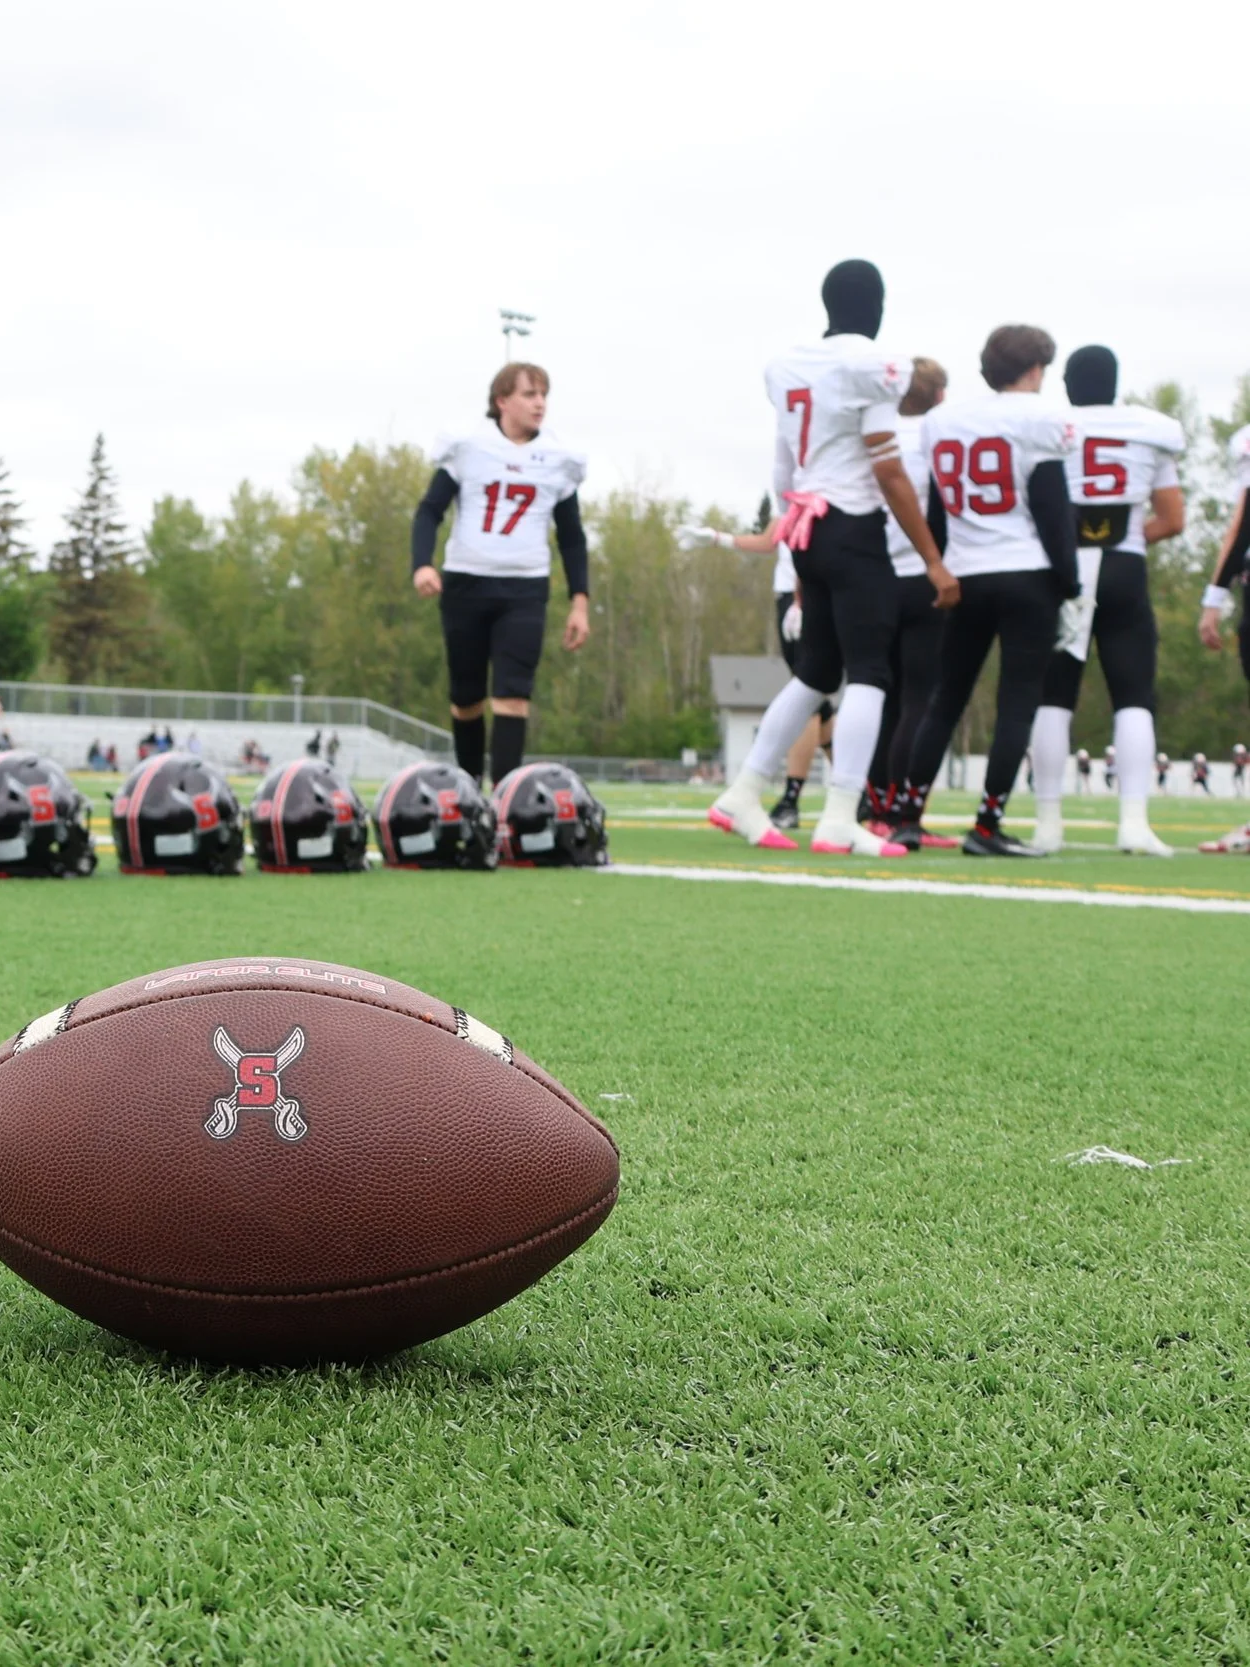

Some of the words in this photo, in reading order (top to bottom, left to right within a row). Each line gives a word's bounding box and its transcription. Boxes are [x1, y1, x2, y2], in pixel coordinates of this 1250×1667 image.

[787, 387, 812, 468] 7
[933, 436, 1017, 517] 89
[1083, 436, 1128, 497] 5
[482, 480, 537, 536] 17
[27, 784, 57, 824] S
[192, 791, 220, 832] S
[437, 788, 463, 823] S
[553, 789, 578, 822] S
[275, 965, 387, 995] ELITE
[237, 1055, 278, 1106] S
